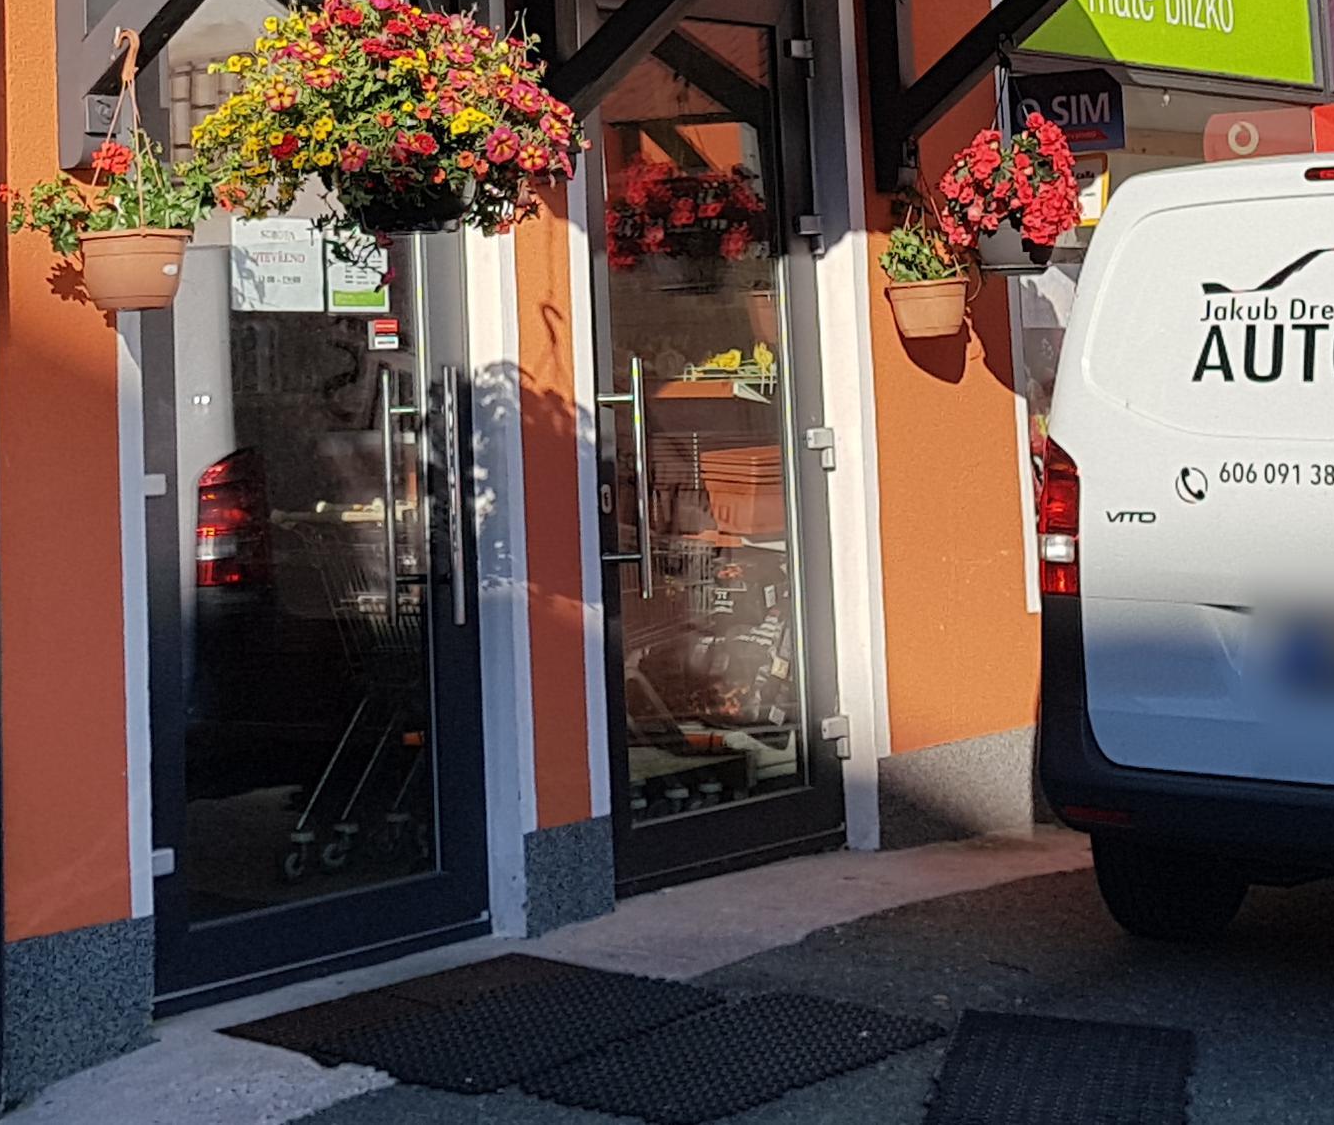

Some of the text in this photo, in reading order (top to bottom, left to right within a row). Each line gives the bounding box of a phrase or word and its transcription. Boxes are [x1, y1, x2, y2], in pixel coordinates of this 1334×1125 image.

[1052, 92, 1110, 125] SIM
[1200, 297, 1278, 321] Jakub
[1220, 462, 1258, 483] 606
[1264, 463, 1301, 485] 091
[1106, 511, 1157, 523] VITO
